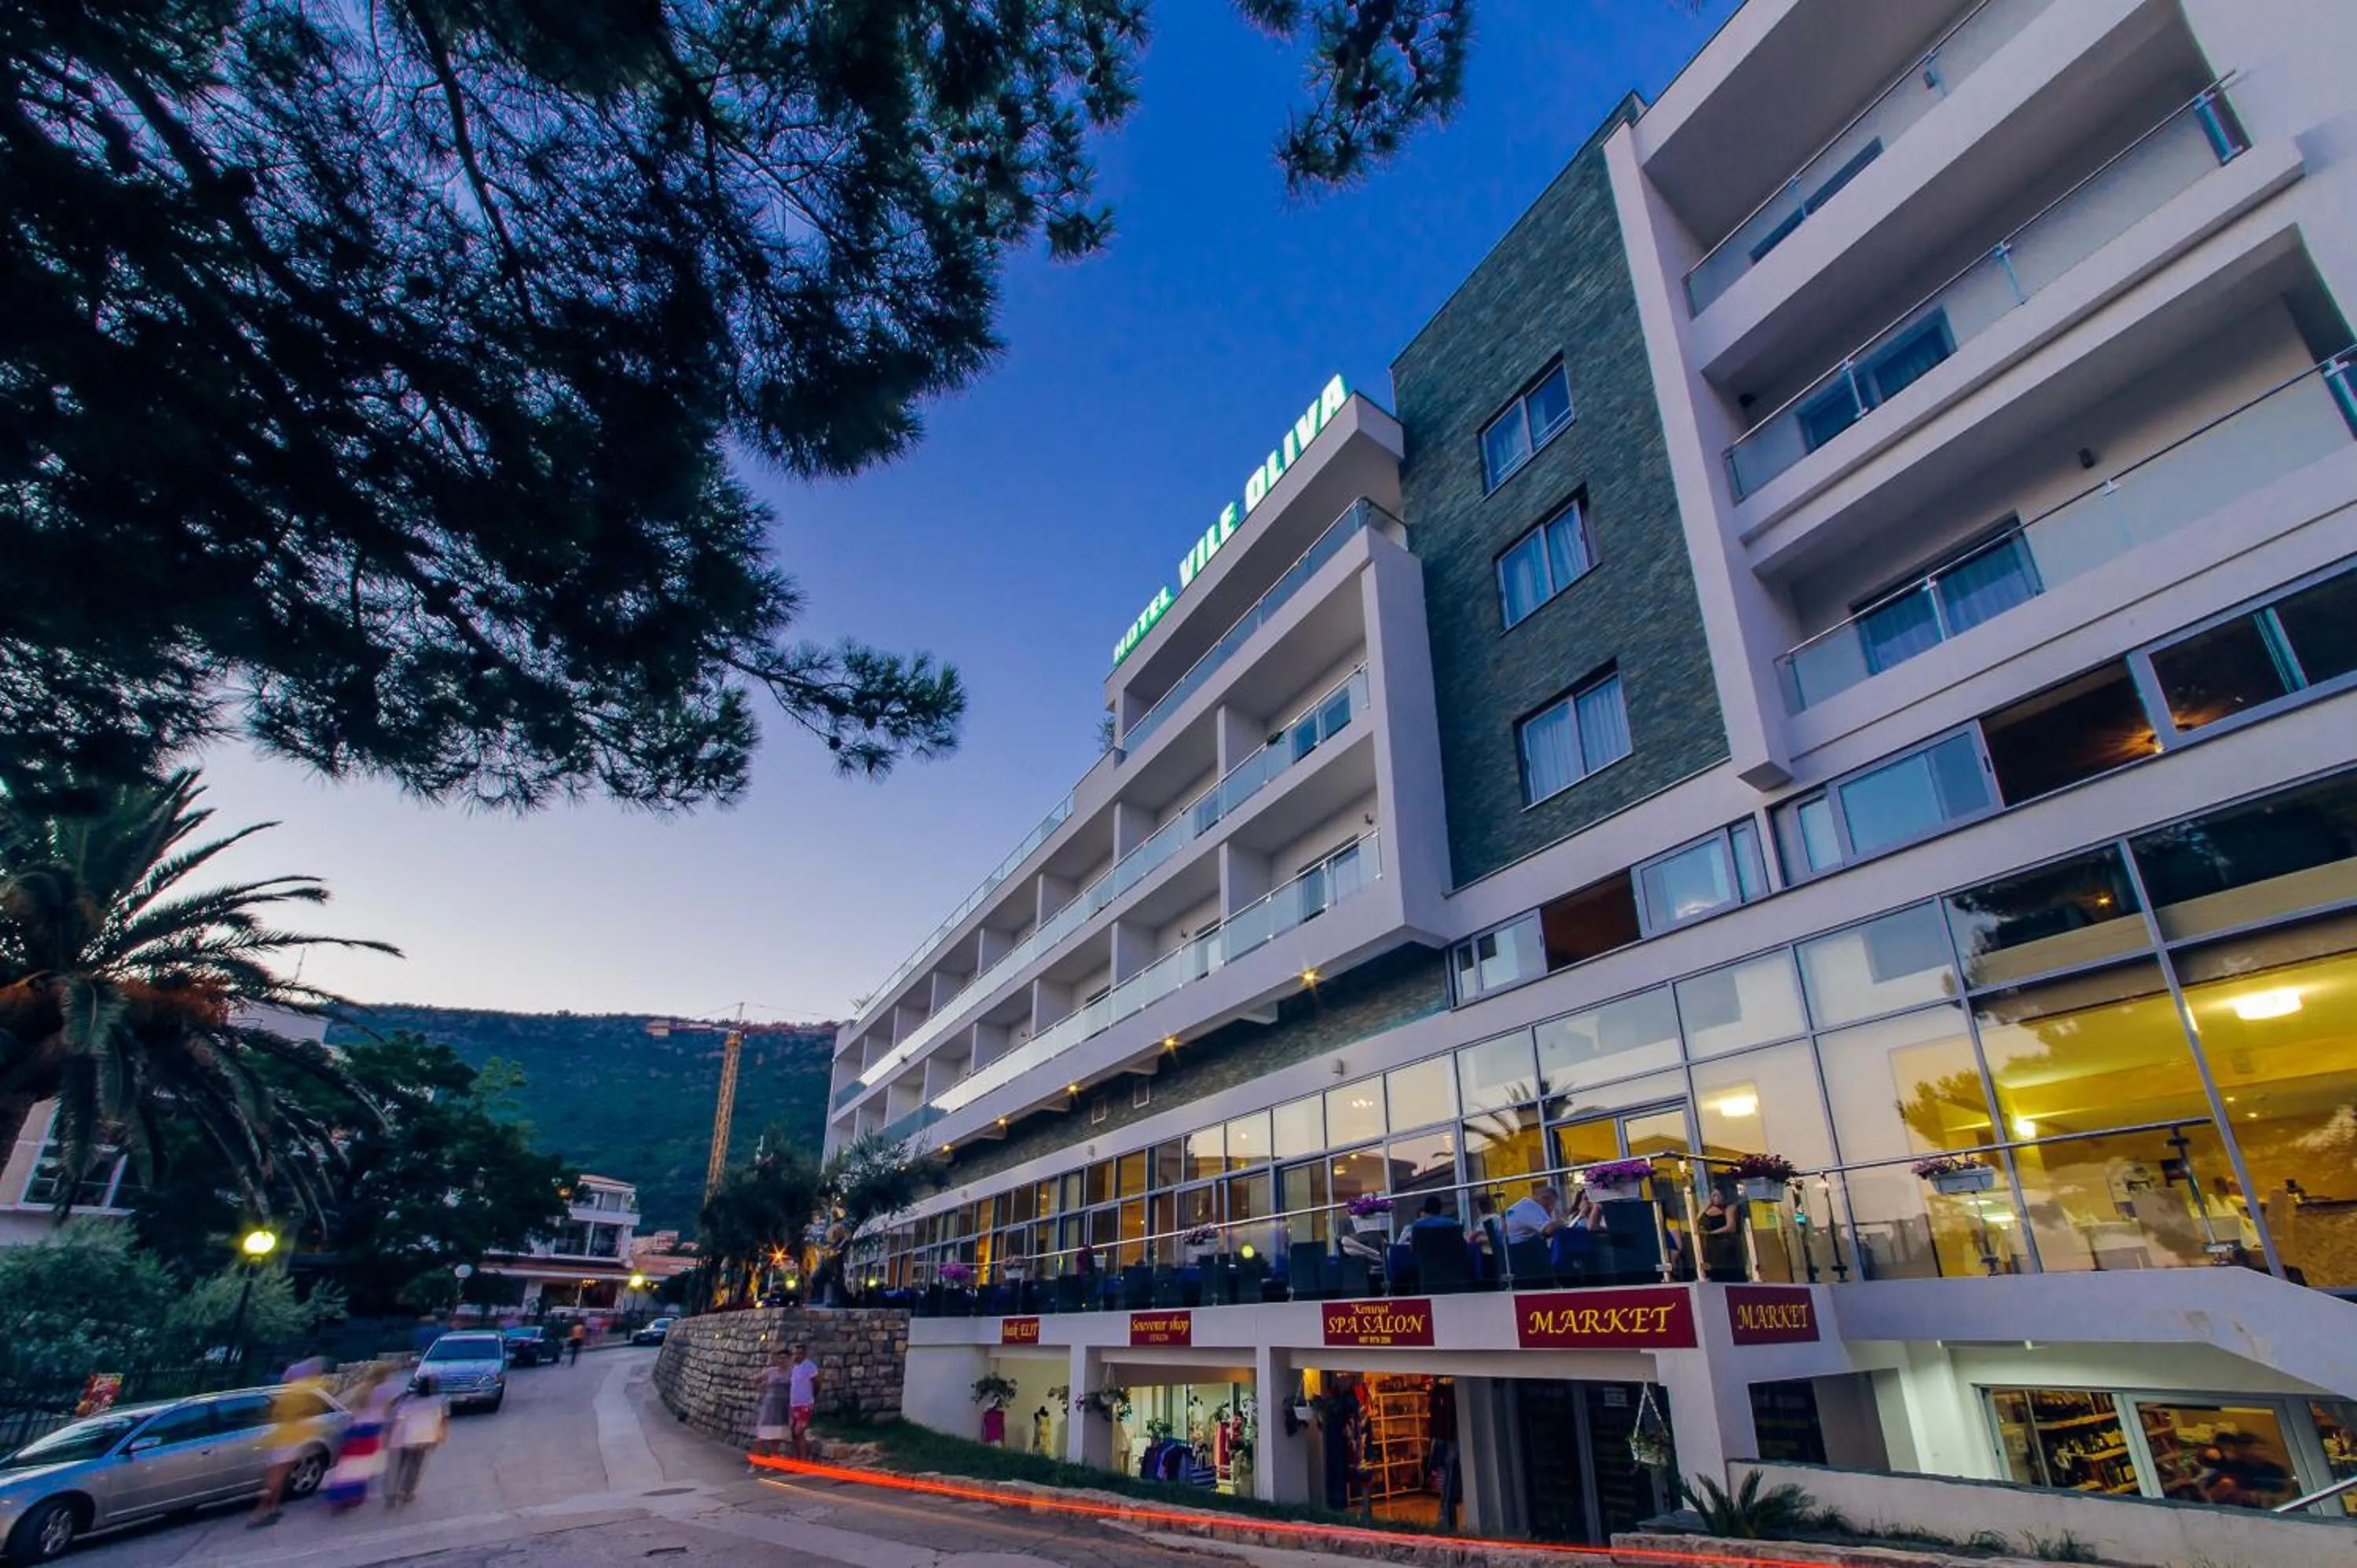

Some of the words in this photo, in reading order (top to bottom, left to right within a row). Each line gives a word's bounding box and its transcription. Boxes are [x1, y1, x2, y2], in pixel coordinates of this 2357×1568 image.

[1112, 584, 1175, 664] HOTEL
[1179, 501, 1239, 588] VILE
[1245, 373, 1350, 513] OLIVA
[1327, 1316, 1358, 1333] SPA
[1362, 1314, 1426, 1333] SALON
[1528, 1302, 1677, 1335] MARKET
[1737, 1303, 1809, 1330] MARKET
